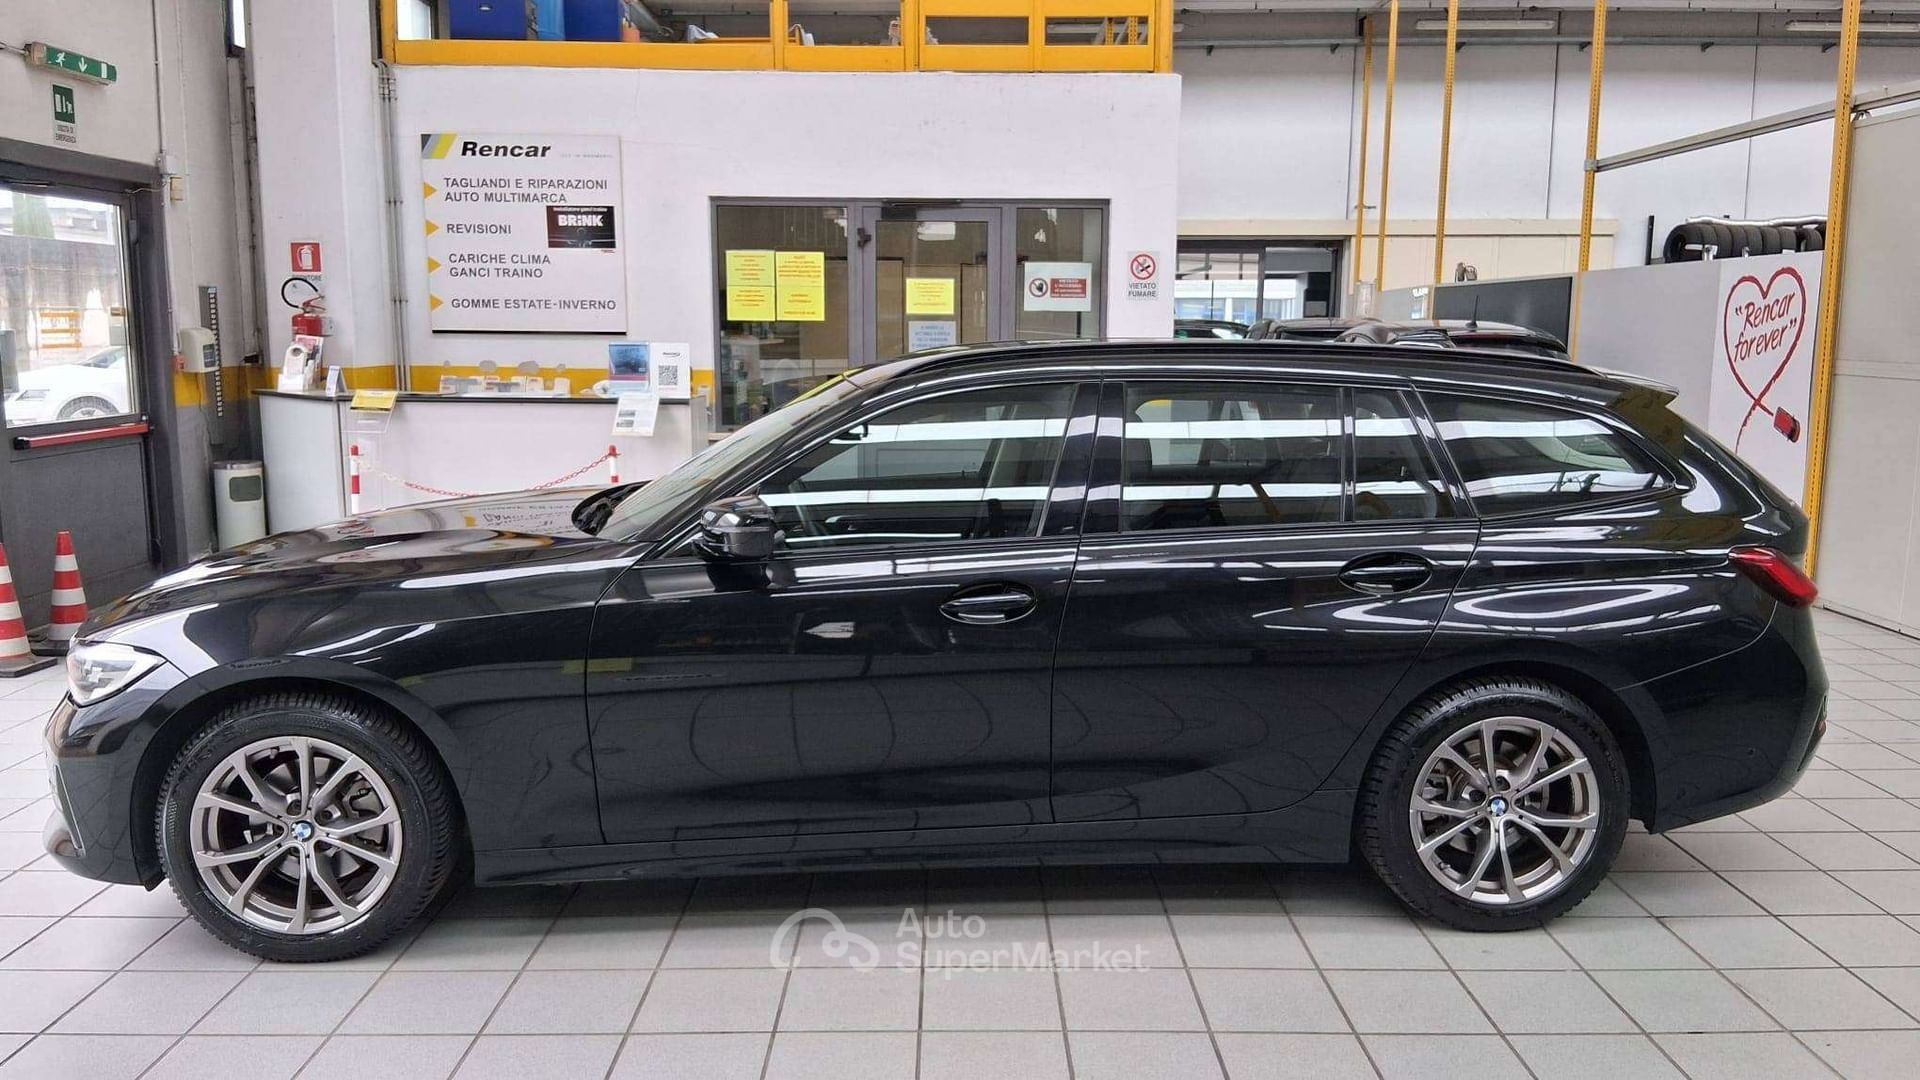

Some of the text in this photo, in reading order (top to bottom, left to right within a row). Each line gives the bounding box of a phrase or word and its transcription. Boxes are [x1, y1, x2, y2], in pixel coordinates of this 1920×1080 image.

[461, 141, 551, 158] Rencar
[444, 177, 608, 190] TAGLIANDI E RIPARAZIONI
[444, 191, 567, 204] AUTO MULTIMARCA
[446, 223, 512, 235] REVISIONI
[448, 253, 551, 265] CARICHE CLIMA
[449, 267, 544, 278] GANCI TRAINO
[1128, 282, 1157, 290] VIETATO
[451, 298, 617, 310] GOMME ESTATE-INVERNO
